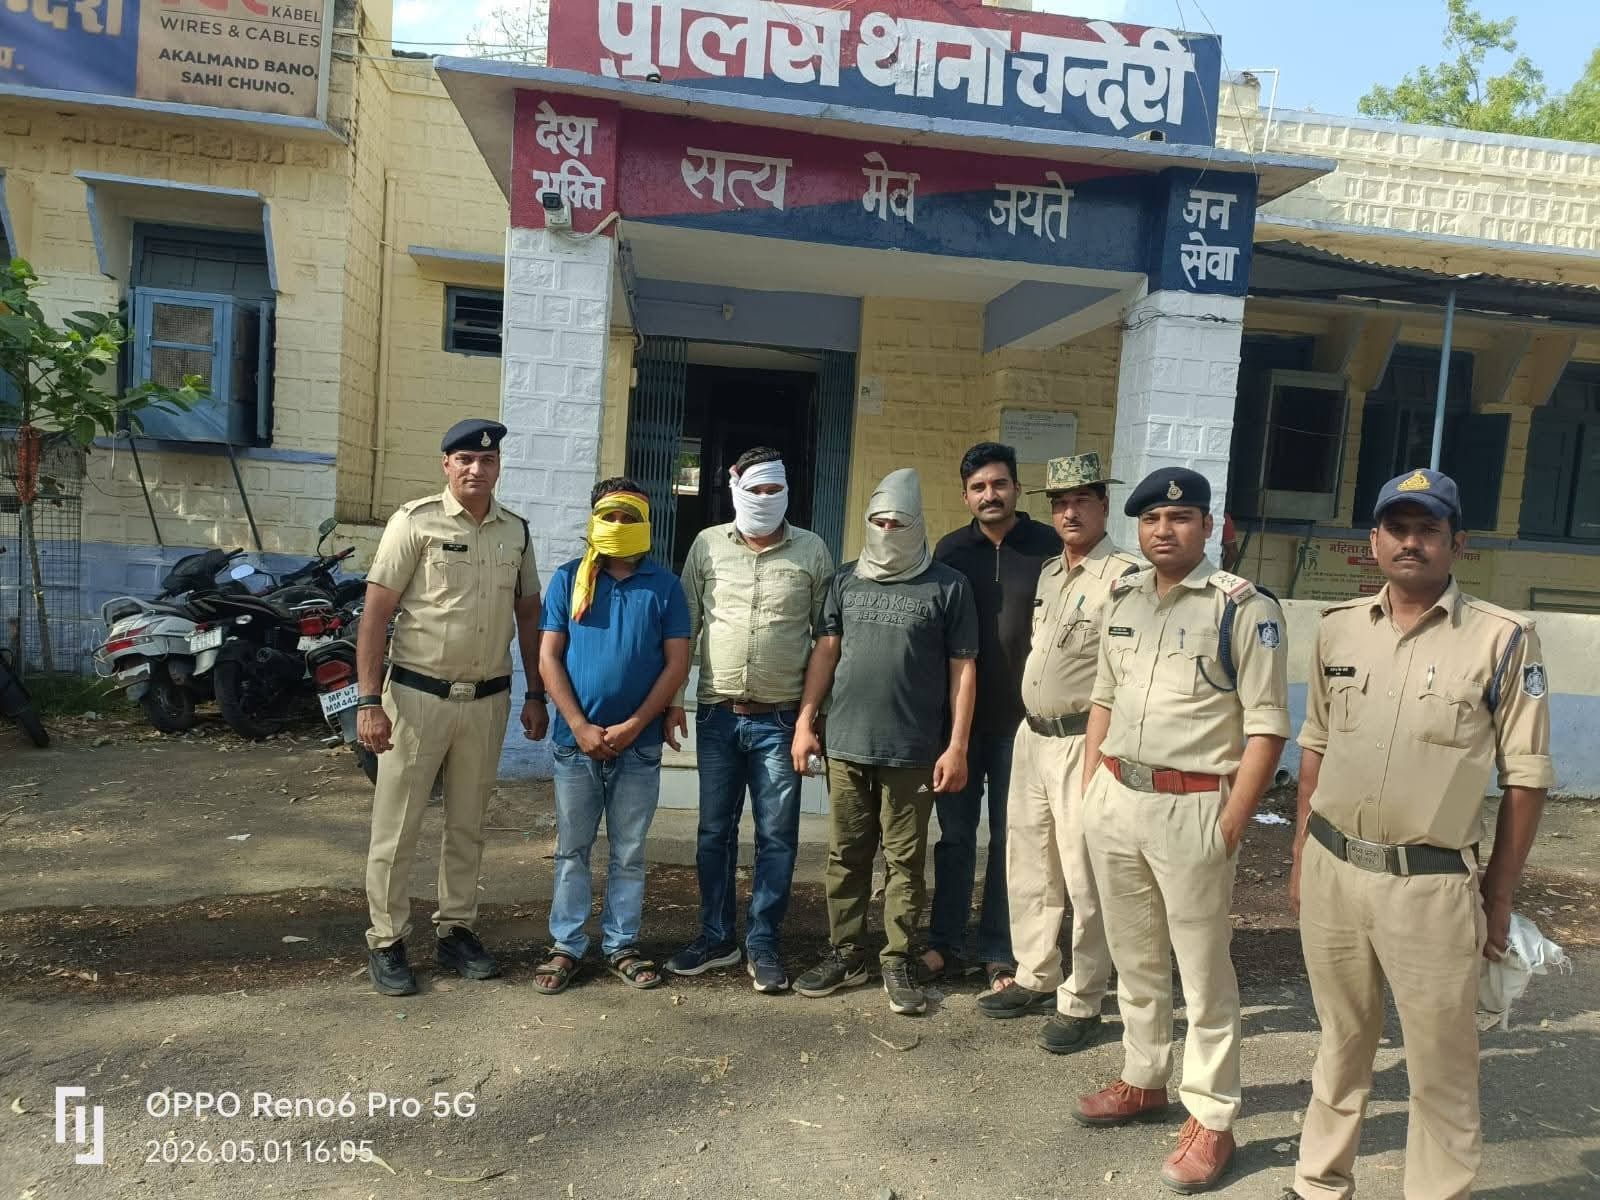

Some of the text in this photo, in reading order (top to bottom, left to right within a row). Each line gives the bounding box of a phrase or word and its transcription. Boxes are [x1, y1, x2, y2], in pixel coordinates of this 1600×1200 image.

[160, 16, 321, 48] WIRES & CABLES
[159, 48, 320, 80] AKALMAND BANO,
[857, 12, 1011, 106] थाना
[1012, 20, 1196, 131] चन्देरी
[181, 71, 295, 96] SAHI CHUNO.
[535, 100, 599, 157] देश
[681, 146, 1074, 243] सत्य मेव जयते
[1182, 188, 1238, 231] जन
[1180, 231, 1241, 289] सेवा
[879, 613, 906, 625] YORK
[891, 594, 928, 617] Klein
